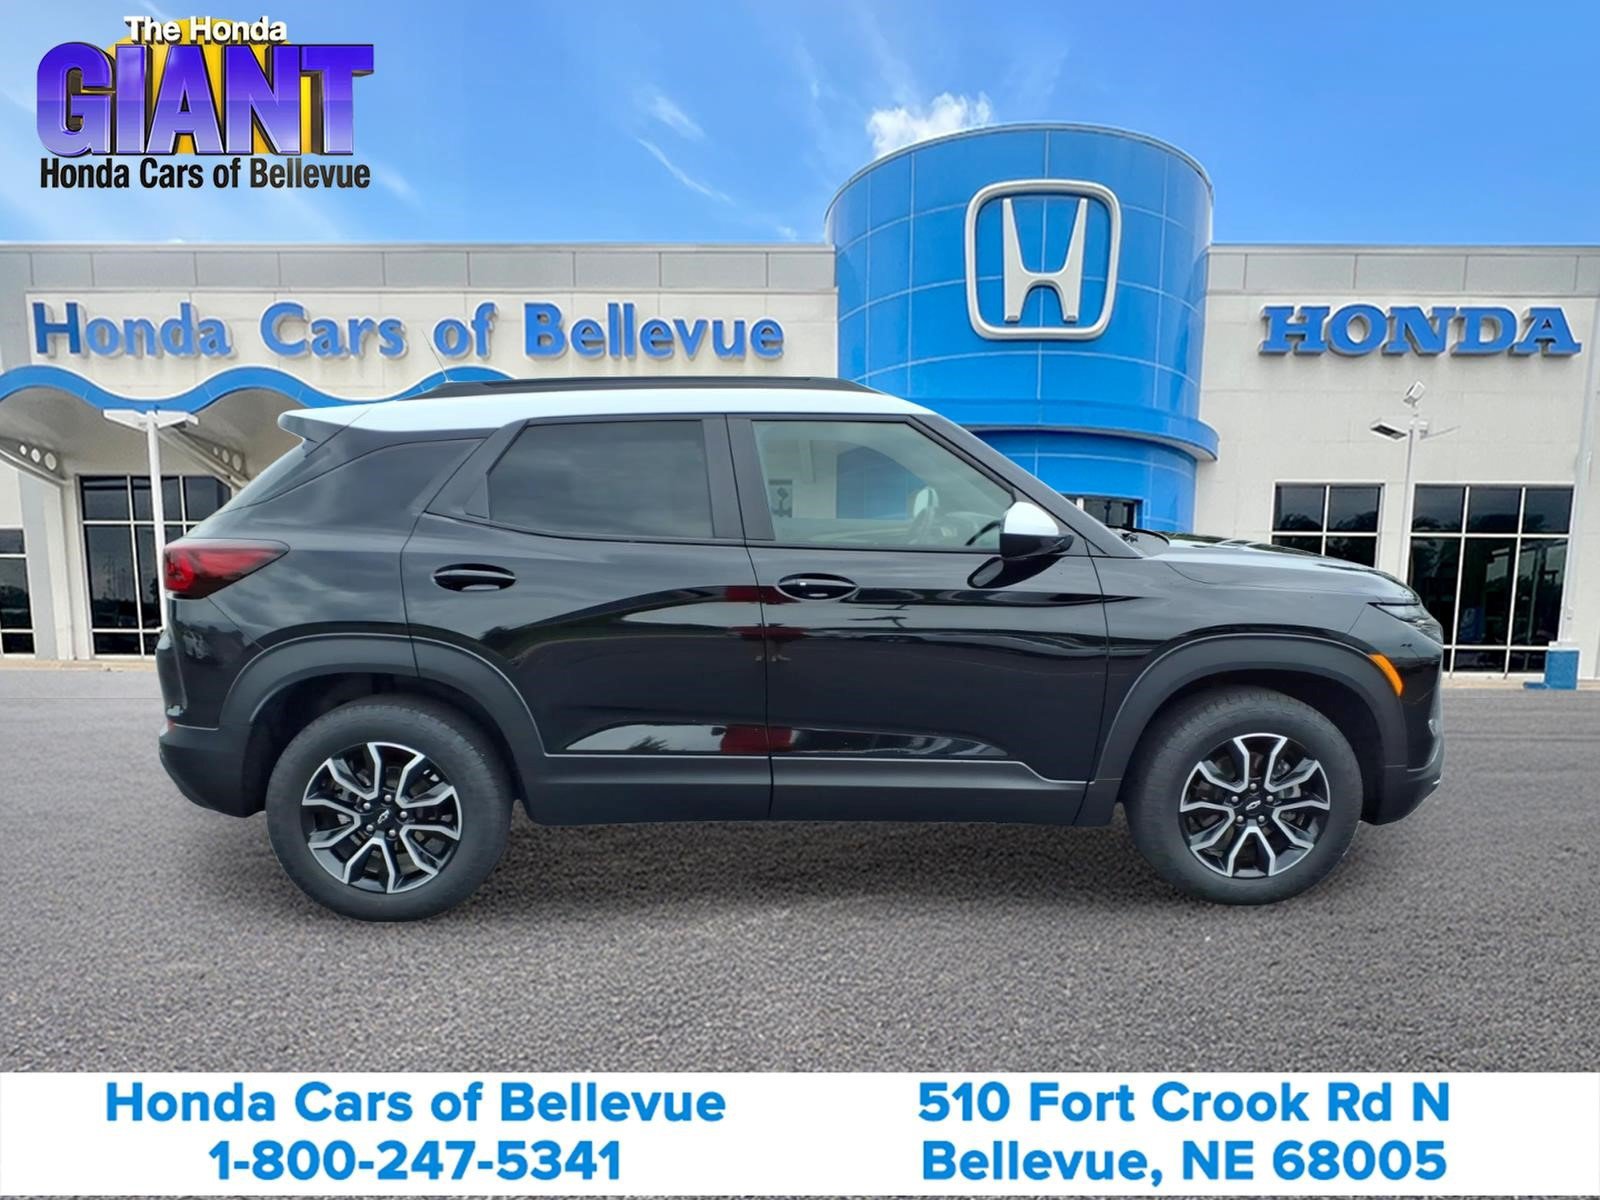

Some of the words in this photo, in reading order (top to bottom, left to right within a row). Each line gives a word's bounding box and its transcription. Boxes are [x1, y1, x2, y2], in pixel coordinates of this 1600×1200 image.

[33, 302, 232, 357] Honda
[260, 302, 405, 357] Cars
[433, 302, 497, 358] of
[524, 302, 785, 358] Bellevue
[1259, 304, 1582, 356] HONDA
